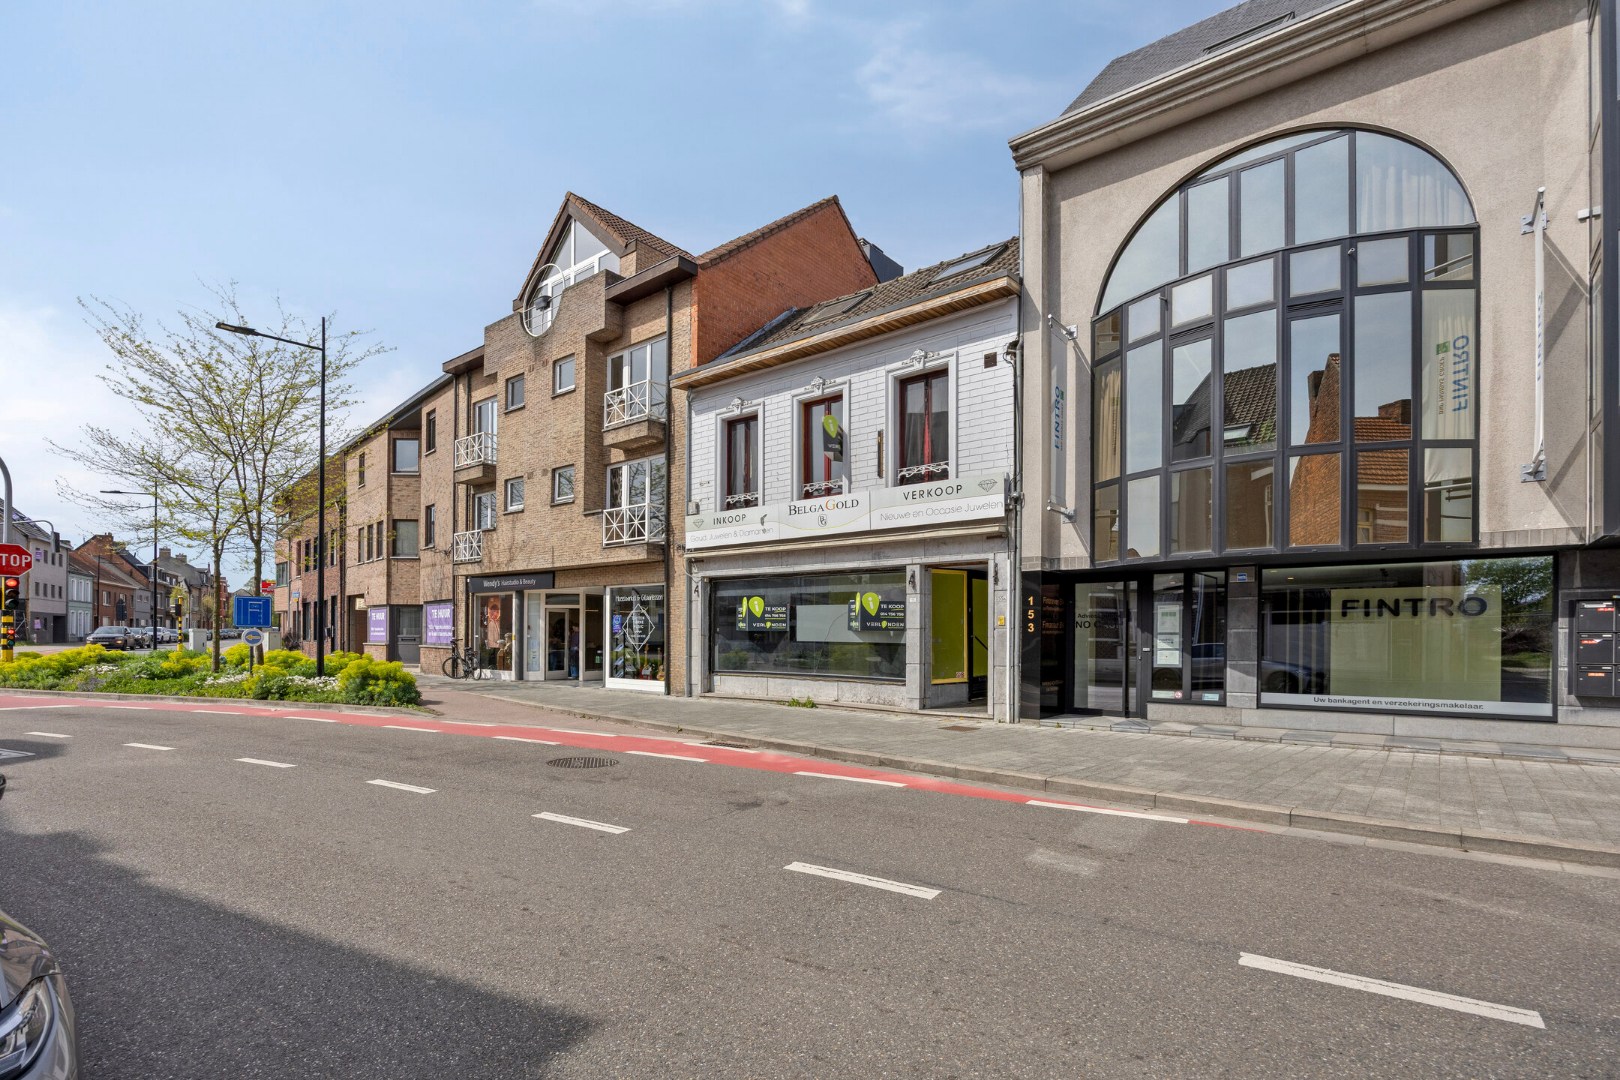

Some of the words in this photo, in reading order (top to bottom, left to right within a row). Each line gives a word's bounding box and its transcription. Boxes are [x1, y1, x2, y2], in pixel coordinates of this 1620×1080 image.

[902, 484, 963, 500] VERKOOP
[880, 512, 911, 521] Nieuwe
[925, 505, 962, 516] Occasie
[964, 500, 1003, 513] Juwelen
[713, 514, 747, 526] INKOOP
[709, 532, 732, 541] Juwelen
[739, 527, 774, 537] Diamanen
[431, 609, 437, 618] TE
[437, 608, 450, 618] HUUR
[1341, 597, 1488, 617] FINTRO
[376, 612, 385, 620] HUUR
[1327, 697, 1370, 706] bankagent
[1384, 700, 1484, 710] verzekeringsmakelaar.
